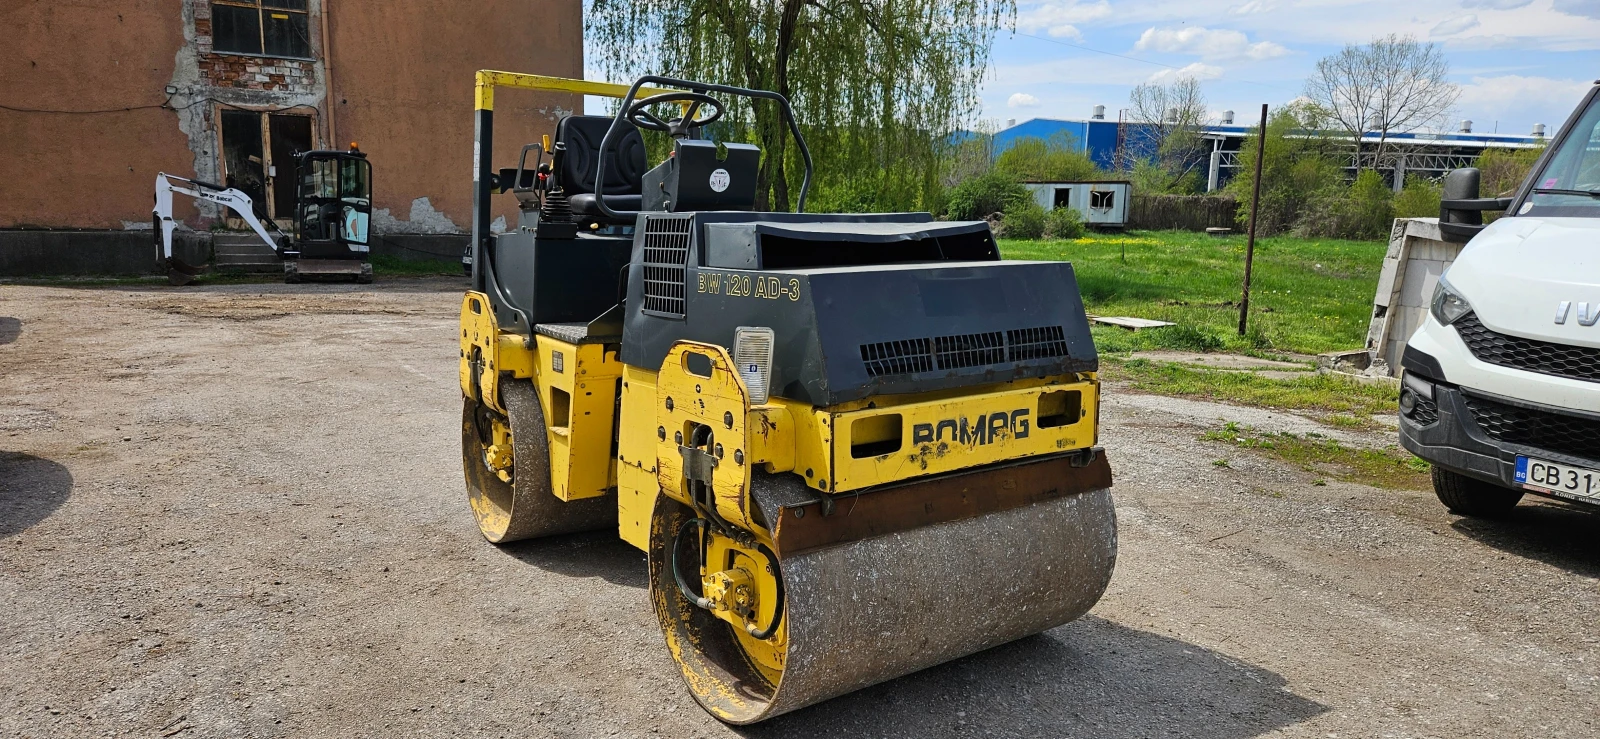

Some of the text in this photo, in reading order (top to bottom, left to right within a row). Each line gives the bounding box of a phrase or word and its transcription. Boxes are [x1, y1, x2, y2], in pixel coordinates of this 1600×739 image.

[698, 272, 800, 302] BW 120 AD-3
[913, 408, 1030, 447] BOMAG
[1516, 471, 1526, 479] BG
[1531, 463, 1560, 486] CB
[1565, 470, 1600, 494] 31
